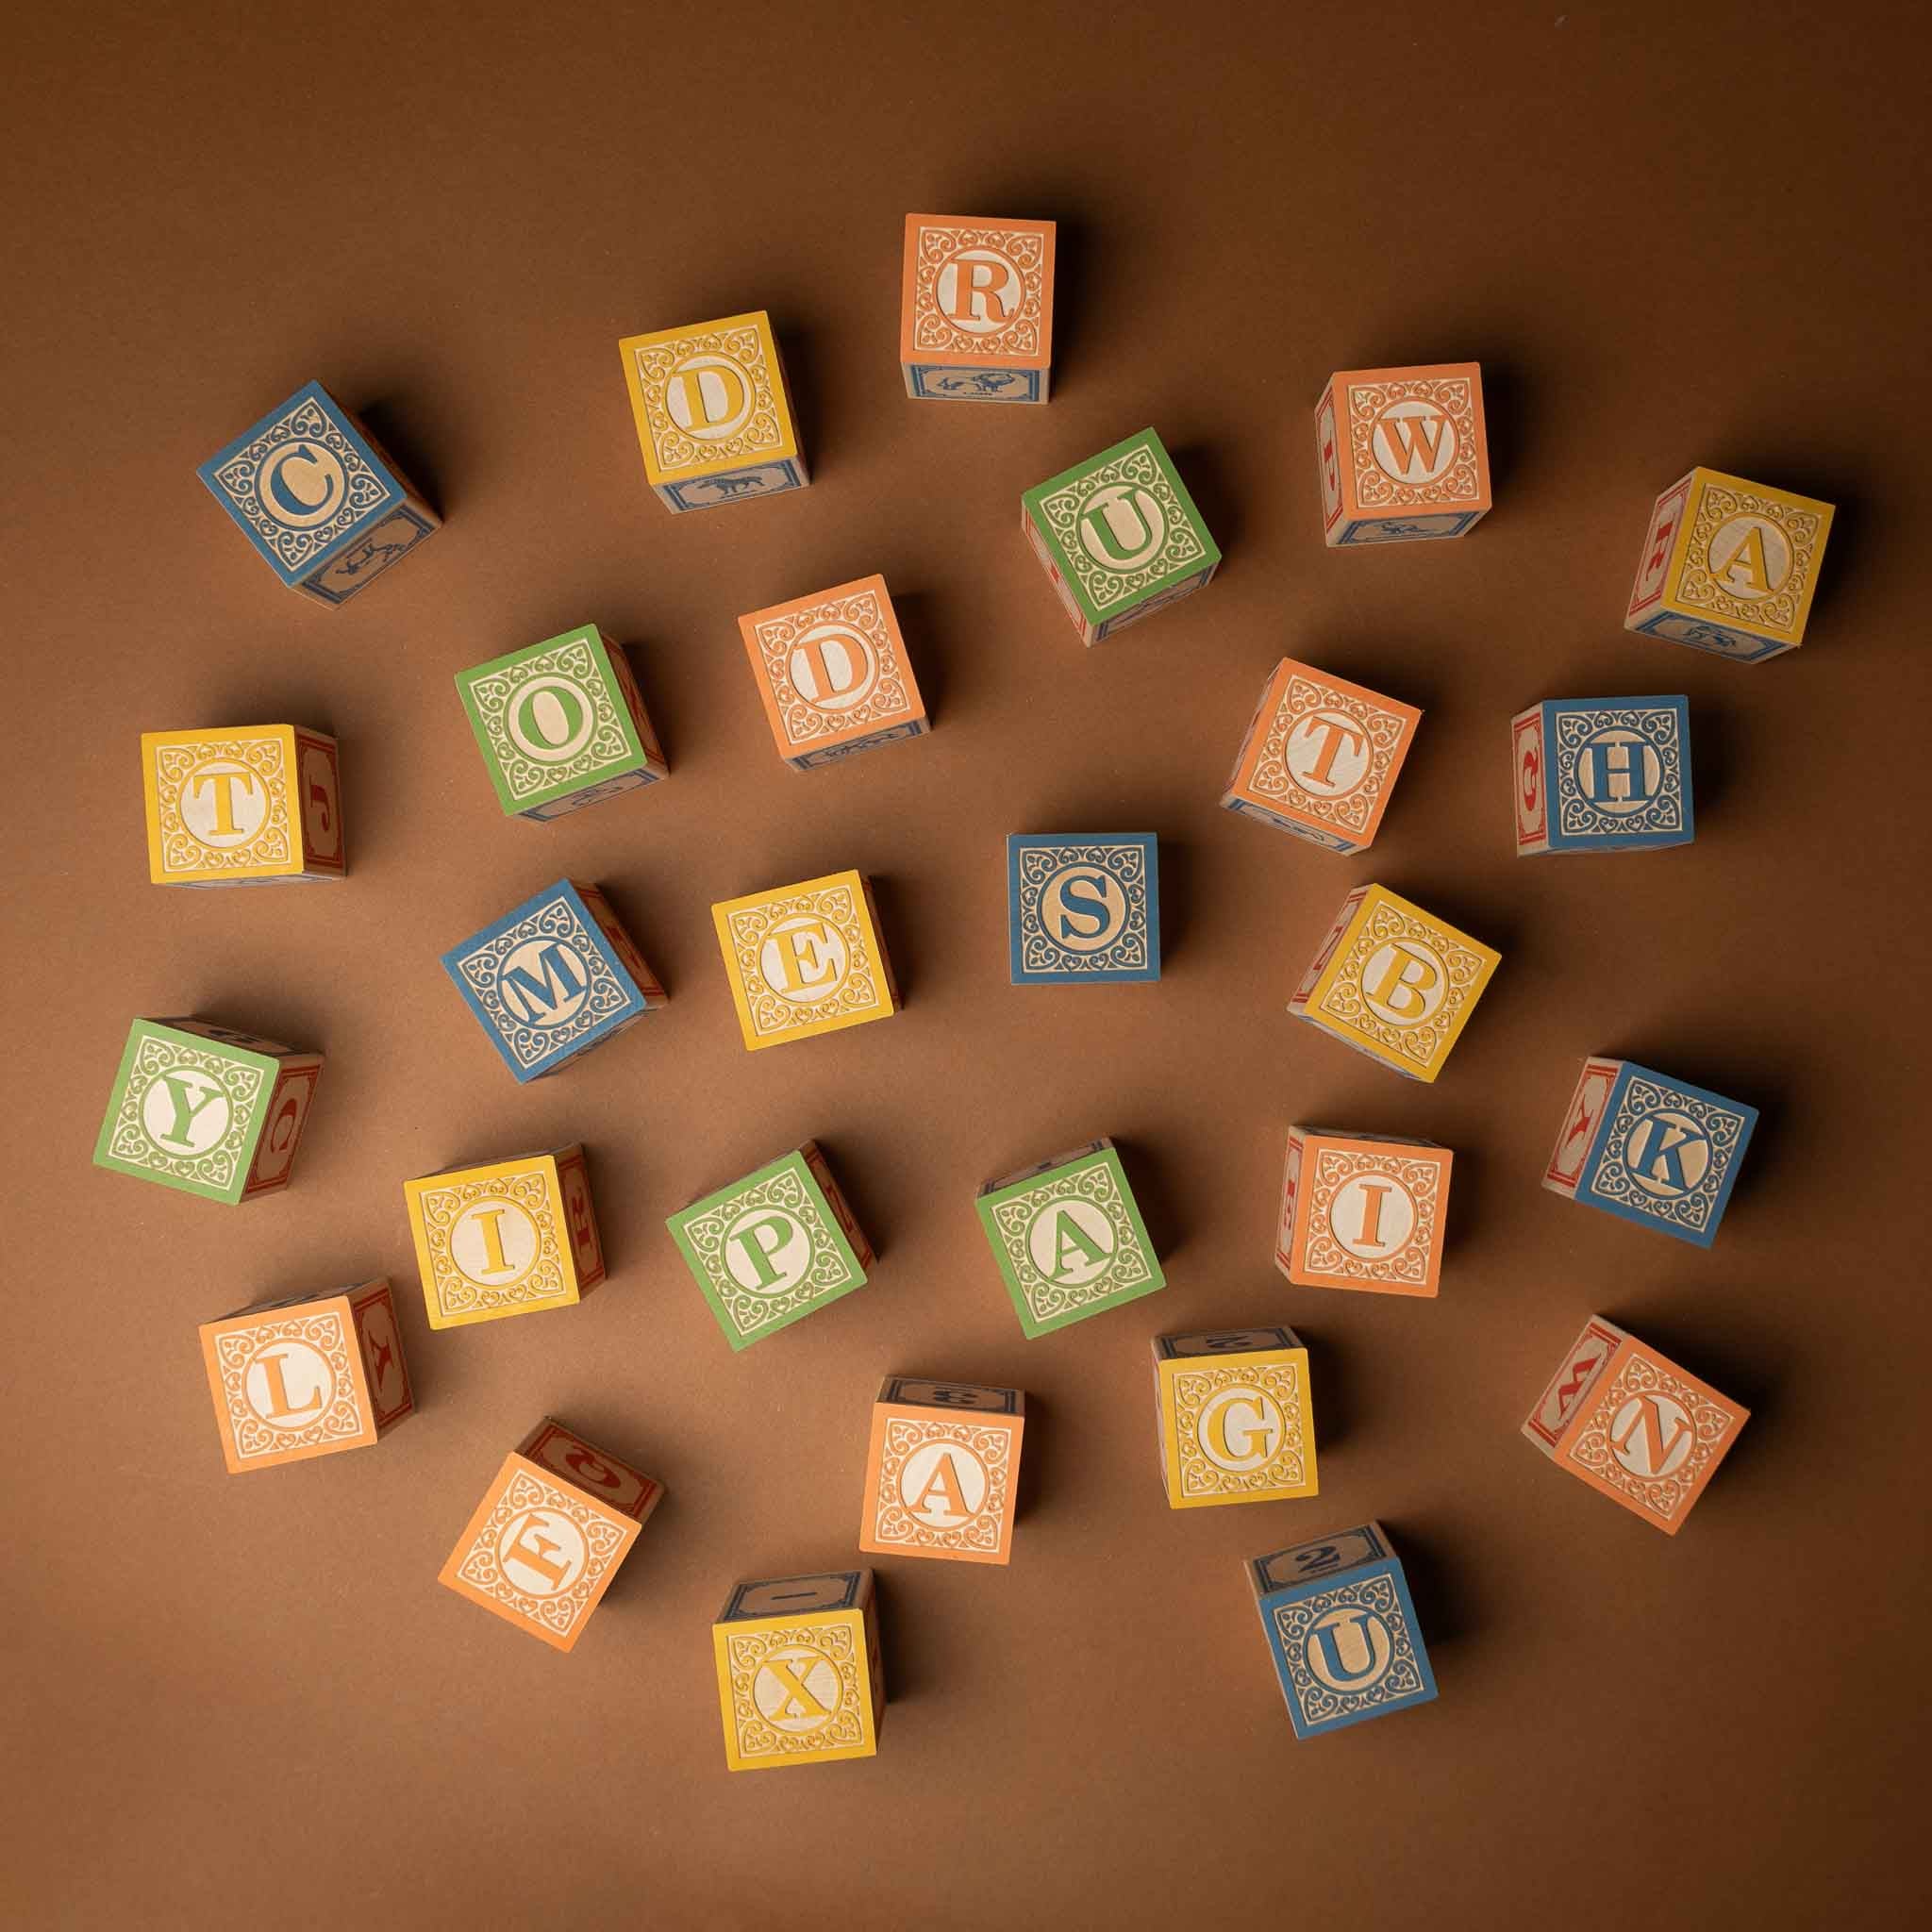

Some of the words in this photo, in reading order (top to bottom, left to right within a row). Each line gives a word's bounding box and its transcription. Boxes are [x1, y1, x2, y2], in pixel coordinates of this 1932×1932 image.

[947, 258, 1014, 323] R
[672, 365, 744, 430] D
[1377, 415, 1447, 475] W
[270, 444, 331, 514] C
[1081, 491, 1153, 561] U
[1646, 521, 1674, 581] R
[1710, 525, 1774, 592] A
[793, 632, 869, 702] D
[518, 686, 583, 750] O
[1301, 717, 1363, 787] T
[1585, 741, 1657, 801] H
[193, 771, 252, 835] T
[309, 774, 330, 830] J
[1060, 874, 1110, 941] S
[501, 943, 587, 1021] M
[769, 923, 838, 993] E
[1365, 942, 1437, 1017] B
[156, 1074, 225, 1147] Y
[271, 1098, 296, 1151] C
[1566, 1100, 1593, 1146] Y
[1630, 1118, 1705, 1191] K
[471, 1208, 515, 1275] I
[1043, 1208, 1118, 1282] A
[1352, 1184, 1391, 1247] I
[728, 1216, 792, 1292] P
[255, 1354, 323, 1417] L
[368, 1331, 393, 1392] Y
[1205, 1398, 1273, 1461] G
[1609, 1395, 1692, 1476] N
[910, 1452, 972, 1517] A
[507, 1515, 572, 1590] F
[1295, 1546, 1340, 1573] 2
[1309, 1616, 1379, 1682] U
[761, 1657, 828, 1721] X
